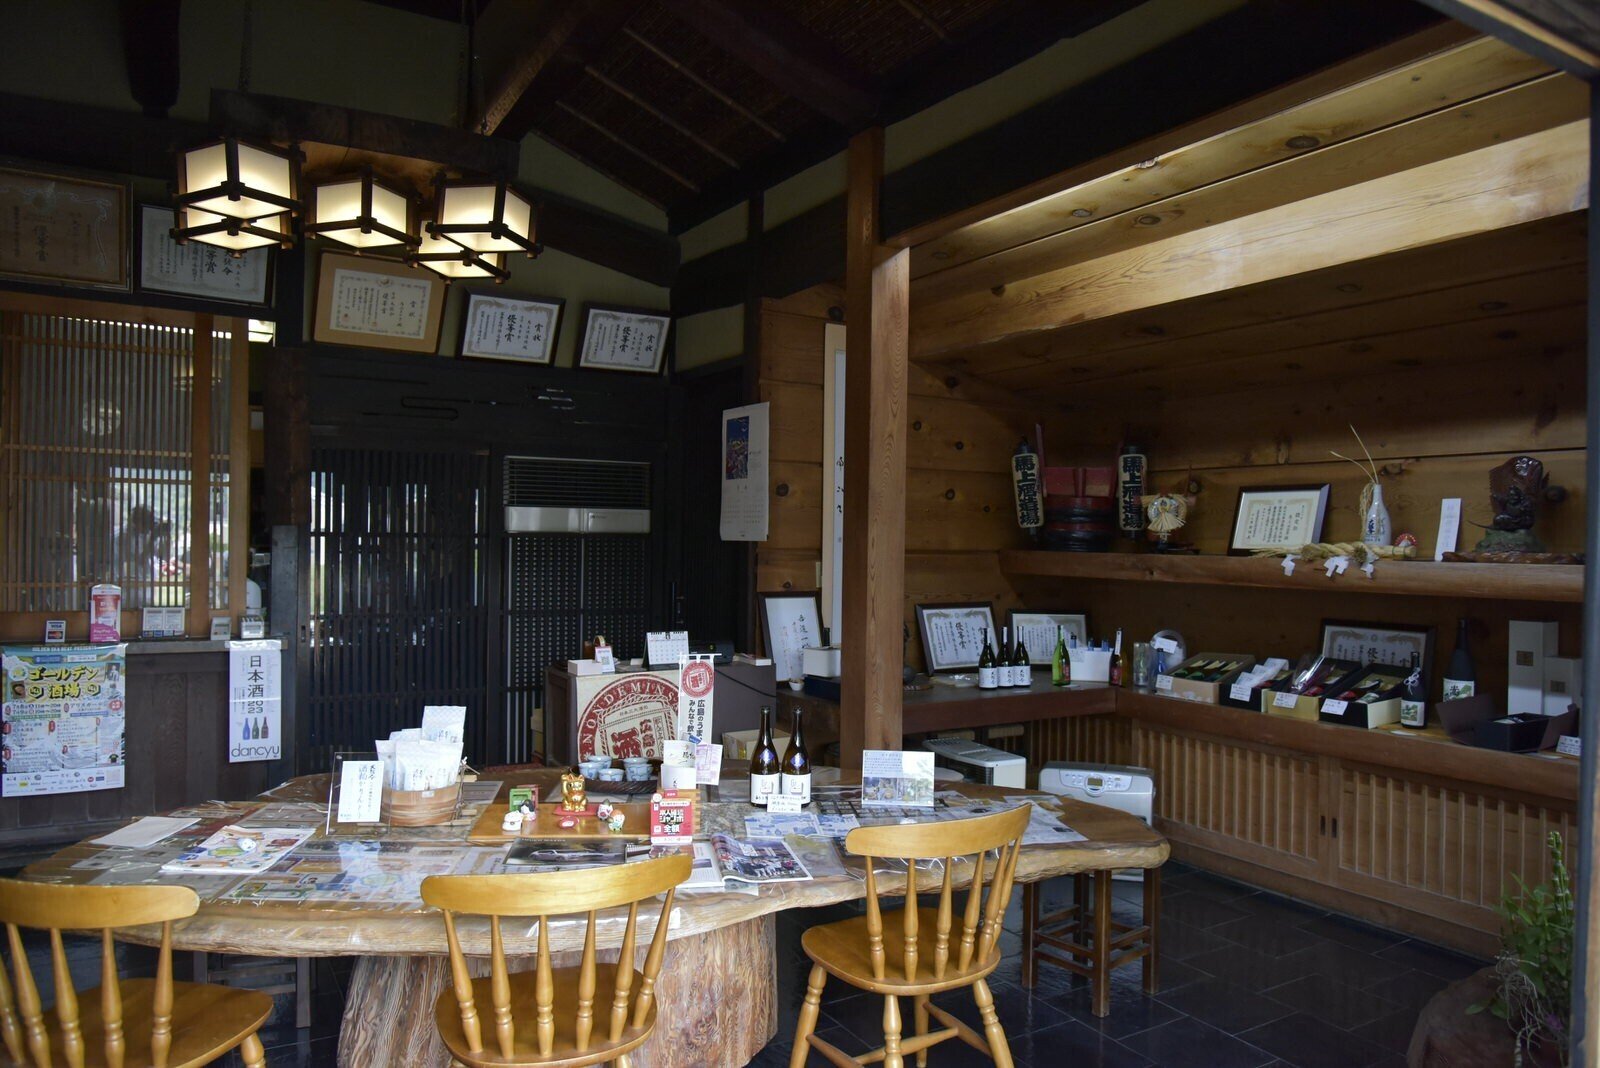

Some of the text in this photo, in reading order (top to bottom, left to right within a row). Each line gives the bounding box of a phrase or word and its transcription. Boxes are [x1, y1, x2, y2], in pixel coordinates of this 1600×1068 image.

[29, 665, 99, 681] ゴールデン
[247, 655, 264, 698] 日本酒
[49, 682, 81, 699] 酒場
[687, 699, 696, 736] みんなで飲
[231, 742, 280, 758] dancyu
[663, 823, 681, 833] 全額
